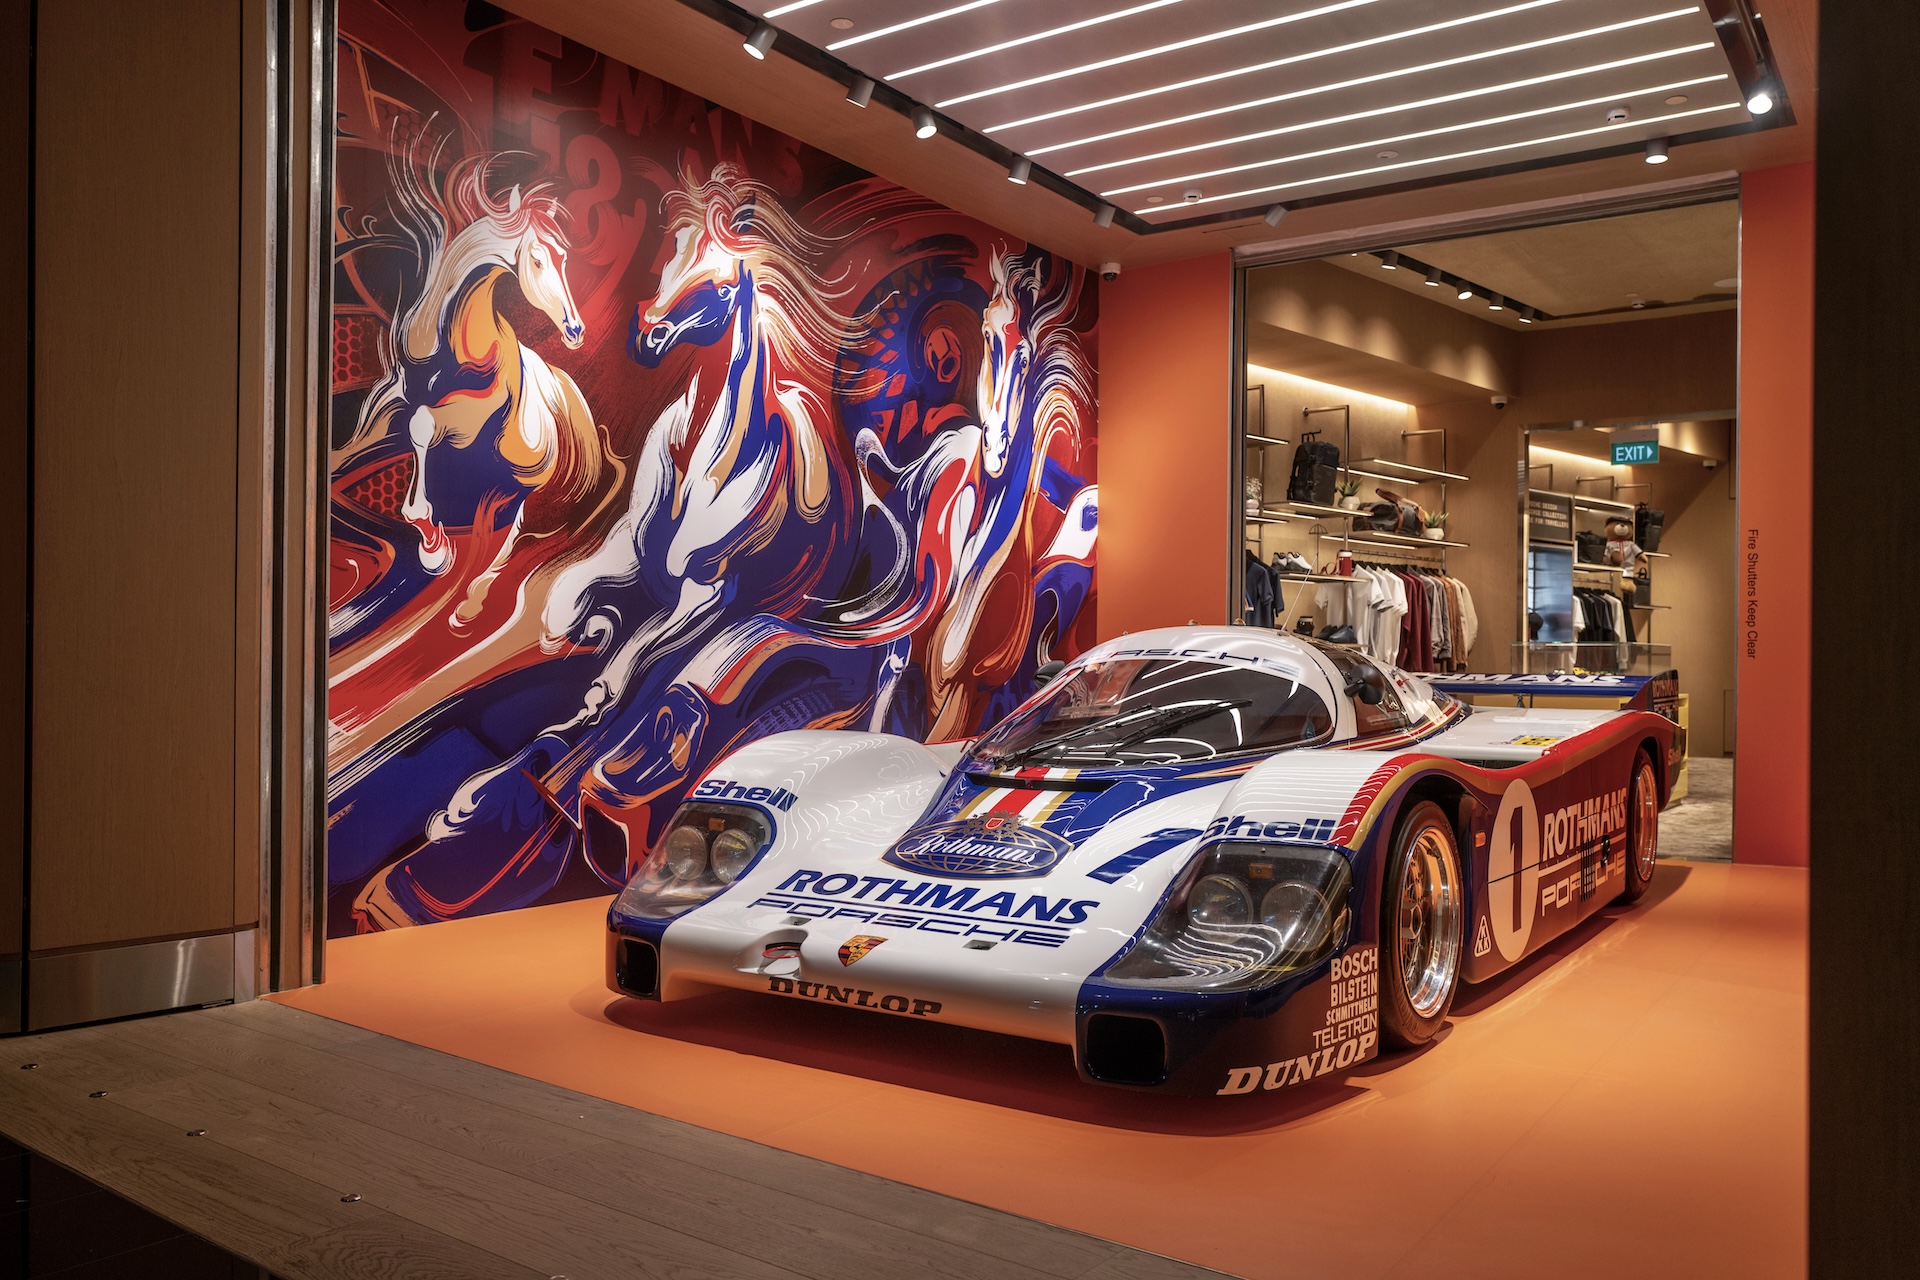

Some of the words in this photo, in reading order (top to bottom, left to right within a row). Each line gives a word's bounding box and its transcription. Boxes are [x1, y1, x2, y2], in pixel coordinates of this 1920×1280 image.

[1615, 445, 1645, 462] EXIT
[1747, 529, 1759, 550] Fire
[1747, 552, 1758, 597] Shutters
[1745, 599, 1758, 628] Keep
[1747, 630, 1758, 660] Clear
[694, 779, 799, 813] Shell
[1200, 815, 1337, 843] Shell
[1542, 787, 1627, 864] ROTHMANS
[904, 833, 1041, 868] Rothmans
[1509, 805, 1523, 934] 1
[774, 869, 1101, 924] ROTHMANS
[746, 898, 1071, 948] PORSCHE
[1330, 947, 1378, 982] BOSCH
[767, 976, 943, 1017] DUNLOP
[1330, 971, 1378, 1008] BILSTEIN
[1325, 995, 1378, 1026] SCHMITTHELM
[1312, 1011, 1378, 1049] TELETRON
[1216, 1030, 1377, 1096] DUNLOP
